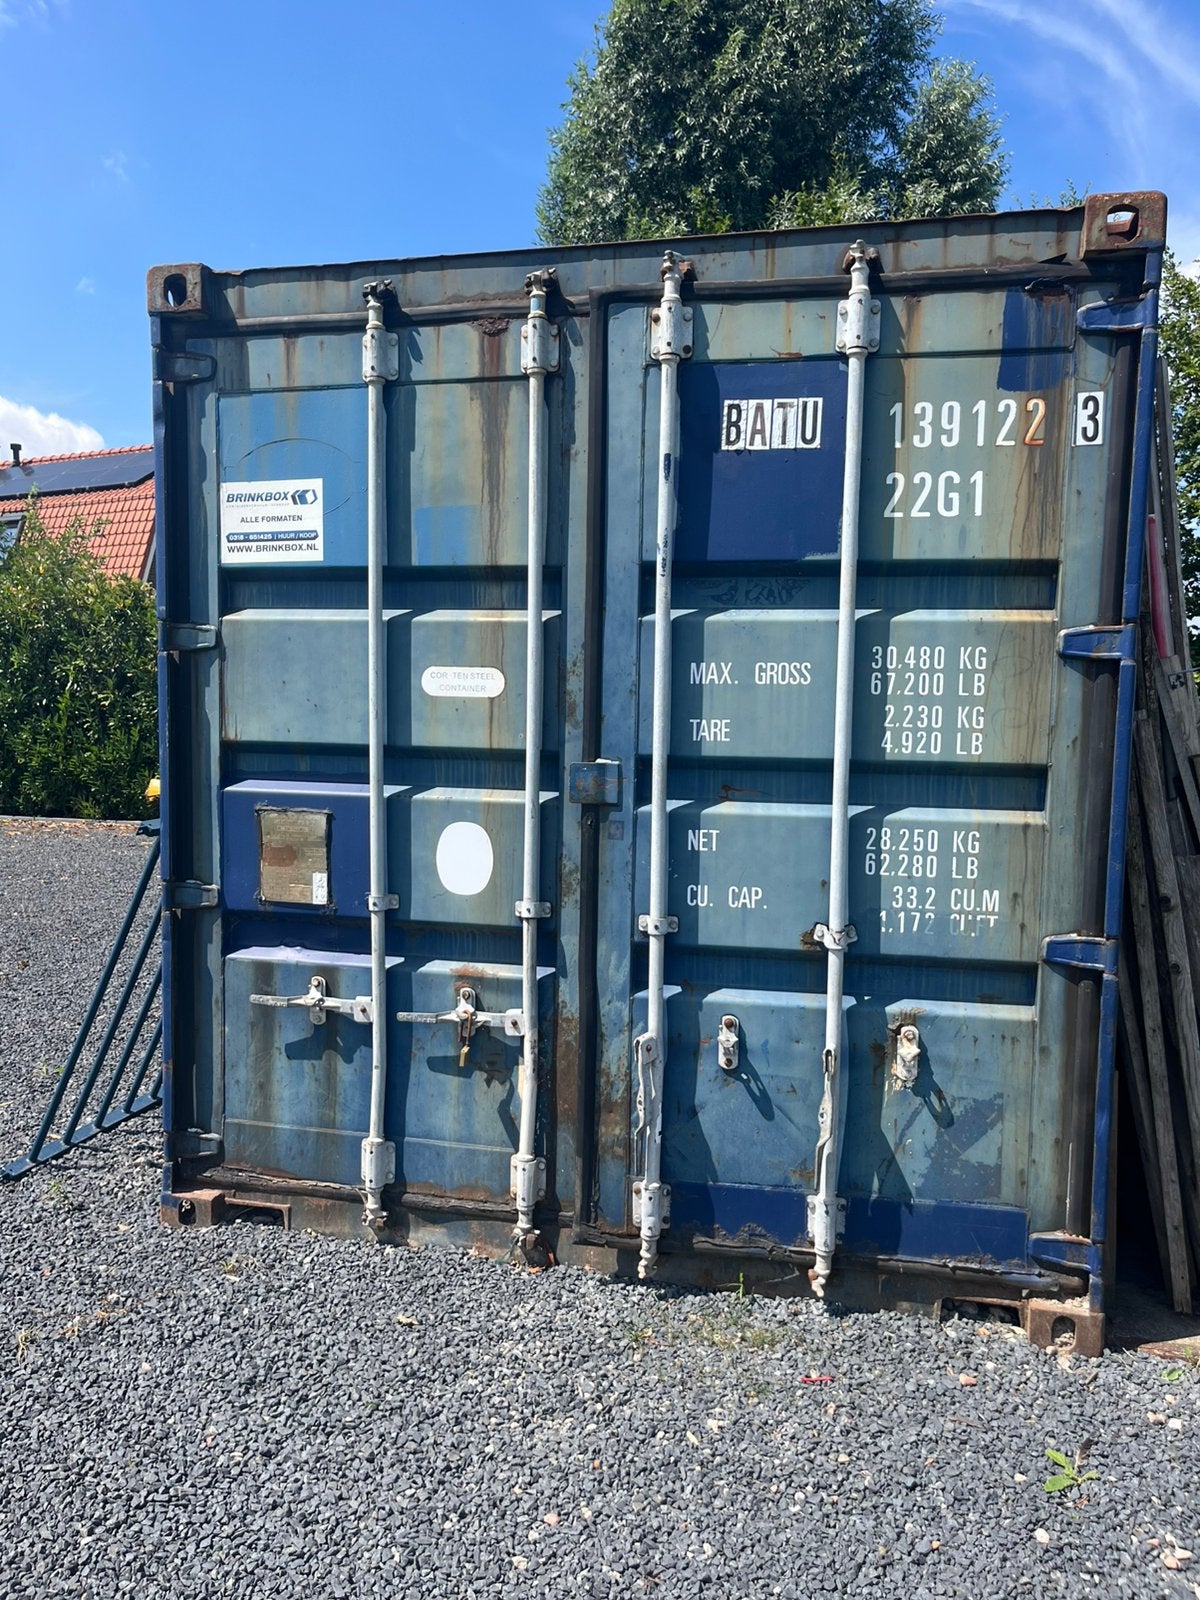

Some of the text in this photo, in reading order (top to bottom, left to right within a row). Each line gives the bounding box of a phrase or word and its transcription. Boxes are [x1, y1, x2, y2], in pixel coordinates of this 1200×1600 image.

[724, 395, 1100, 449] BATU 139122 3
[226, 491, 290, 503] BRINKBOX
[883, 470, 983, 518] 22G1
[261, 515, 303, 523] FORMATEN
[278, 532, 295, 540] HUUR
[299, 531, 317, 539] KOOP
[227, 543, 319, 553] WWW.BRINKBOX.NL
[959, 647, 987, 671] KG
[470, 672, 496, 680] STEEL
[690, 662, 811, 685] MAX. GROSS
[439, 684, 487, 692] CONTAINER
[958, 674, 986, 697] LB
[957, 707, 985, 730] KG
[690, 719, 730, 742] TARE
[956, 732, 983, 755] LB
[687, 829, 720, 852] NET
[952, 830, 980, 854] KG
[951, 856, 979, 879] LB
[687, 884, 768, 909] CU. CAP.
[892, 886, 1000, 912] 33.2 CU.M
